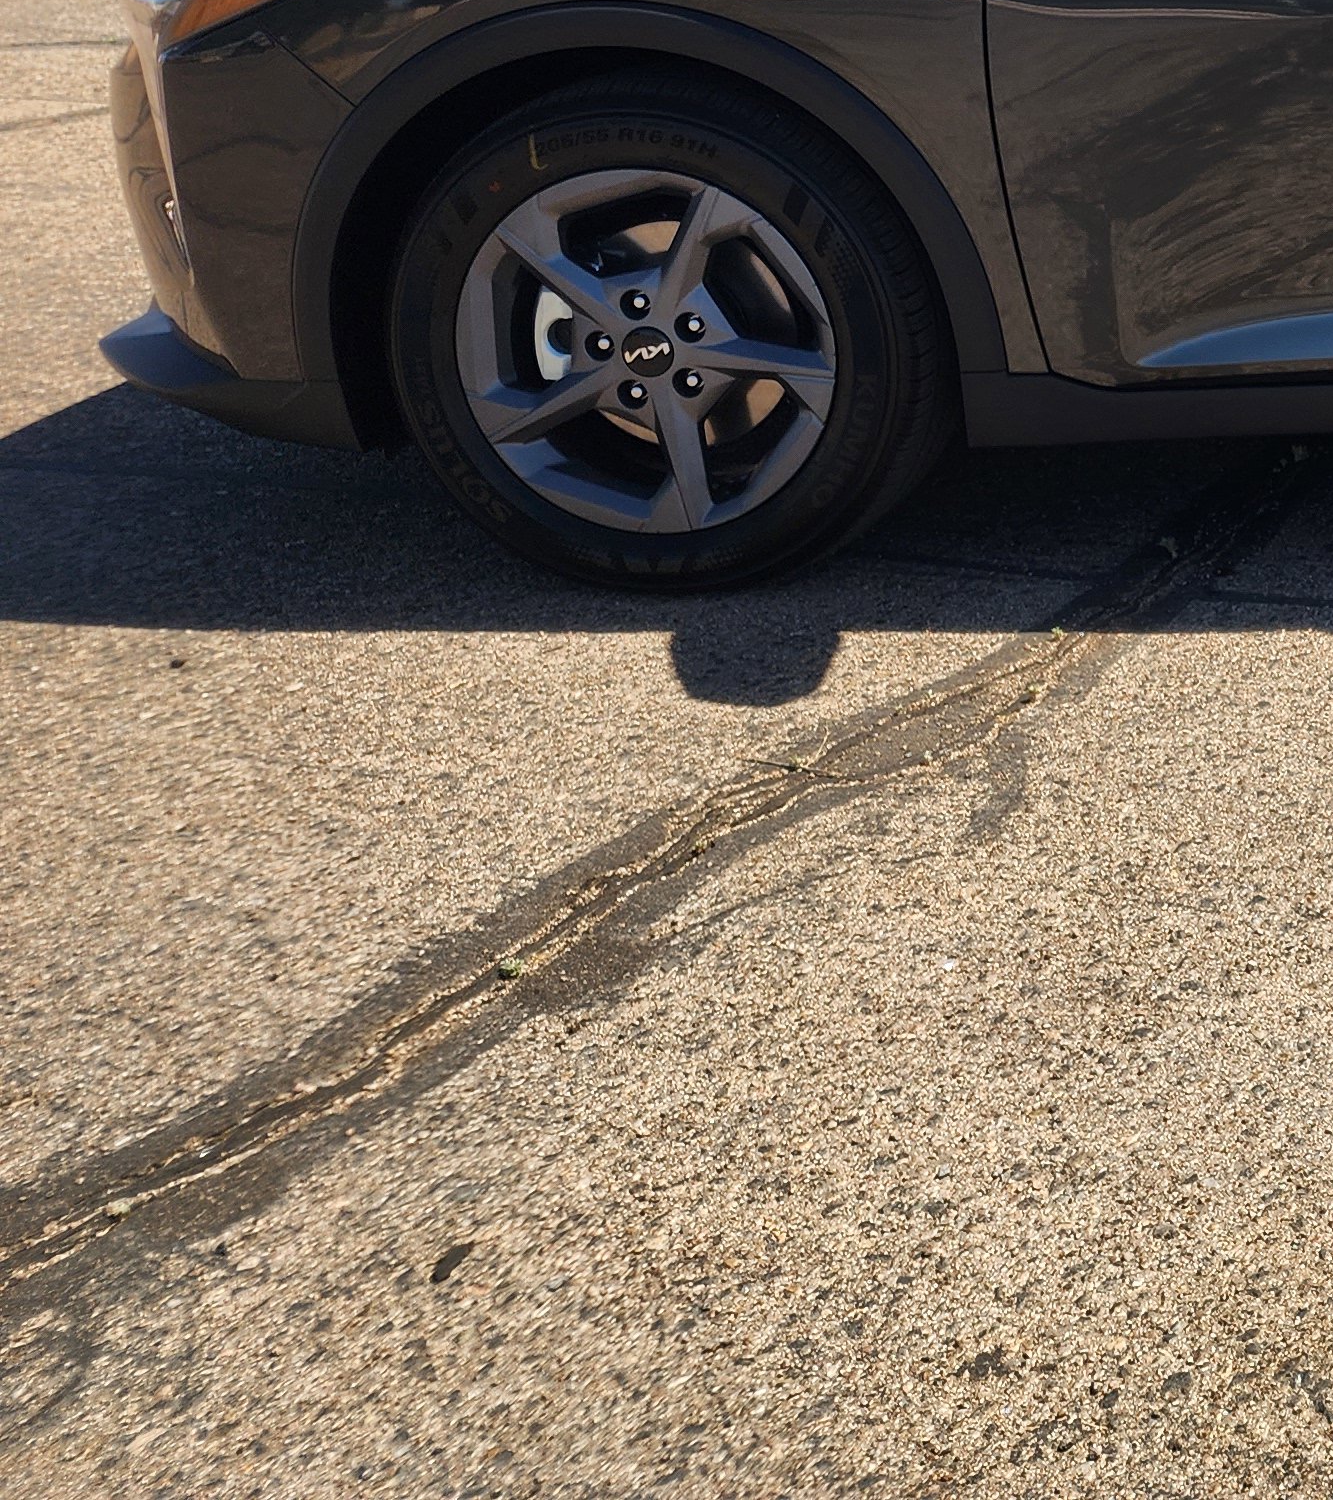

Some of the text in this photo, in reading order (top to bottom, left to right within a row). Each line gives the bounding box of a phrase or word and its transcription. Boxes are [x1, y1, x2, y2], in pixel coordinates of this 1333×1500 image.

[535, 126, 719, 160] 205/55 R16 91H
[624, 342, 671, 363] KIA
